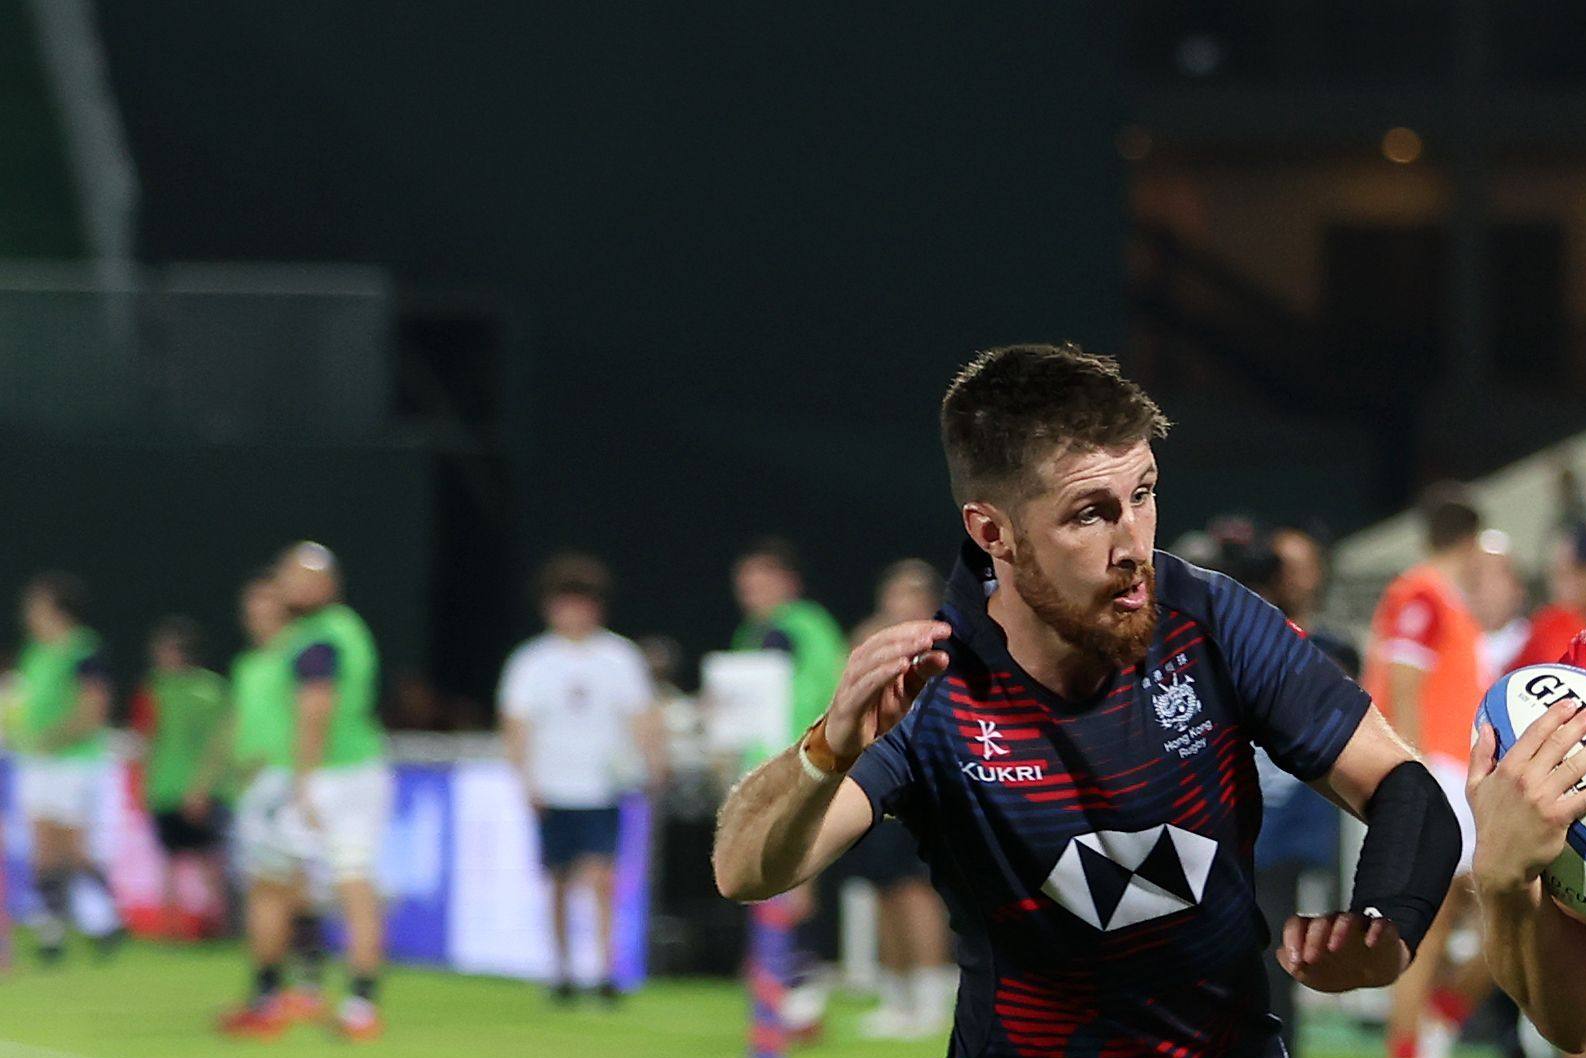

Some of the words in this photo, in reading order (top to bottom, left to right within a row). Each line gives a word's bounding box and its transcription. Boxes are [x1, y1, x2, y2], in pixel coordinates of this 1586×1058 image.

[1163, 734, 1190, 753] Hong
[1188, 719, 1214, 739] Kong
[1178, 737, 1208, 759] Rugby
[958, 760, 1045, 782] KUKRI
